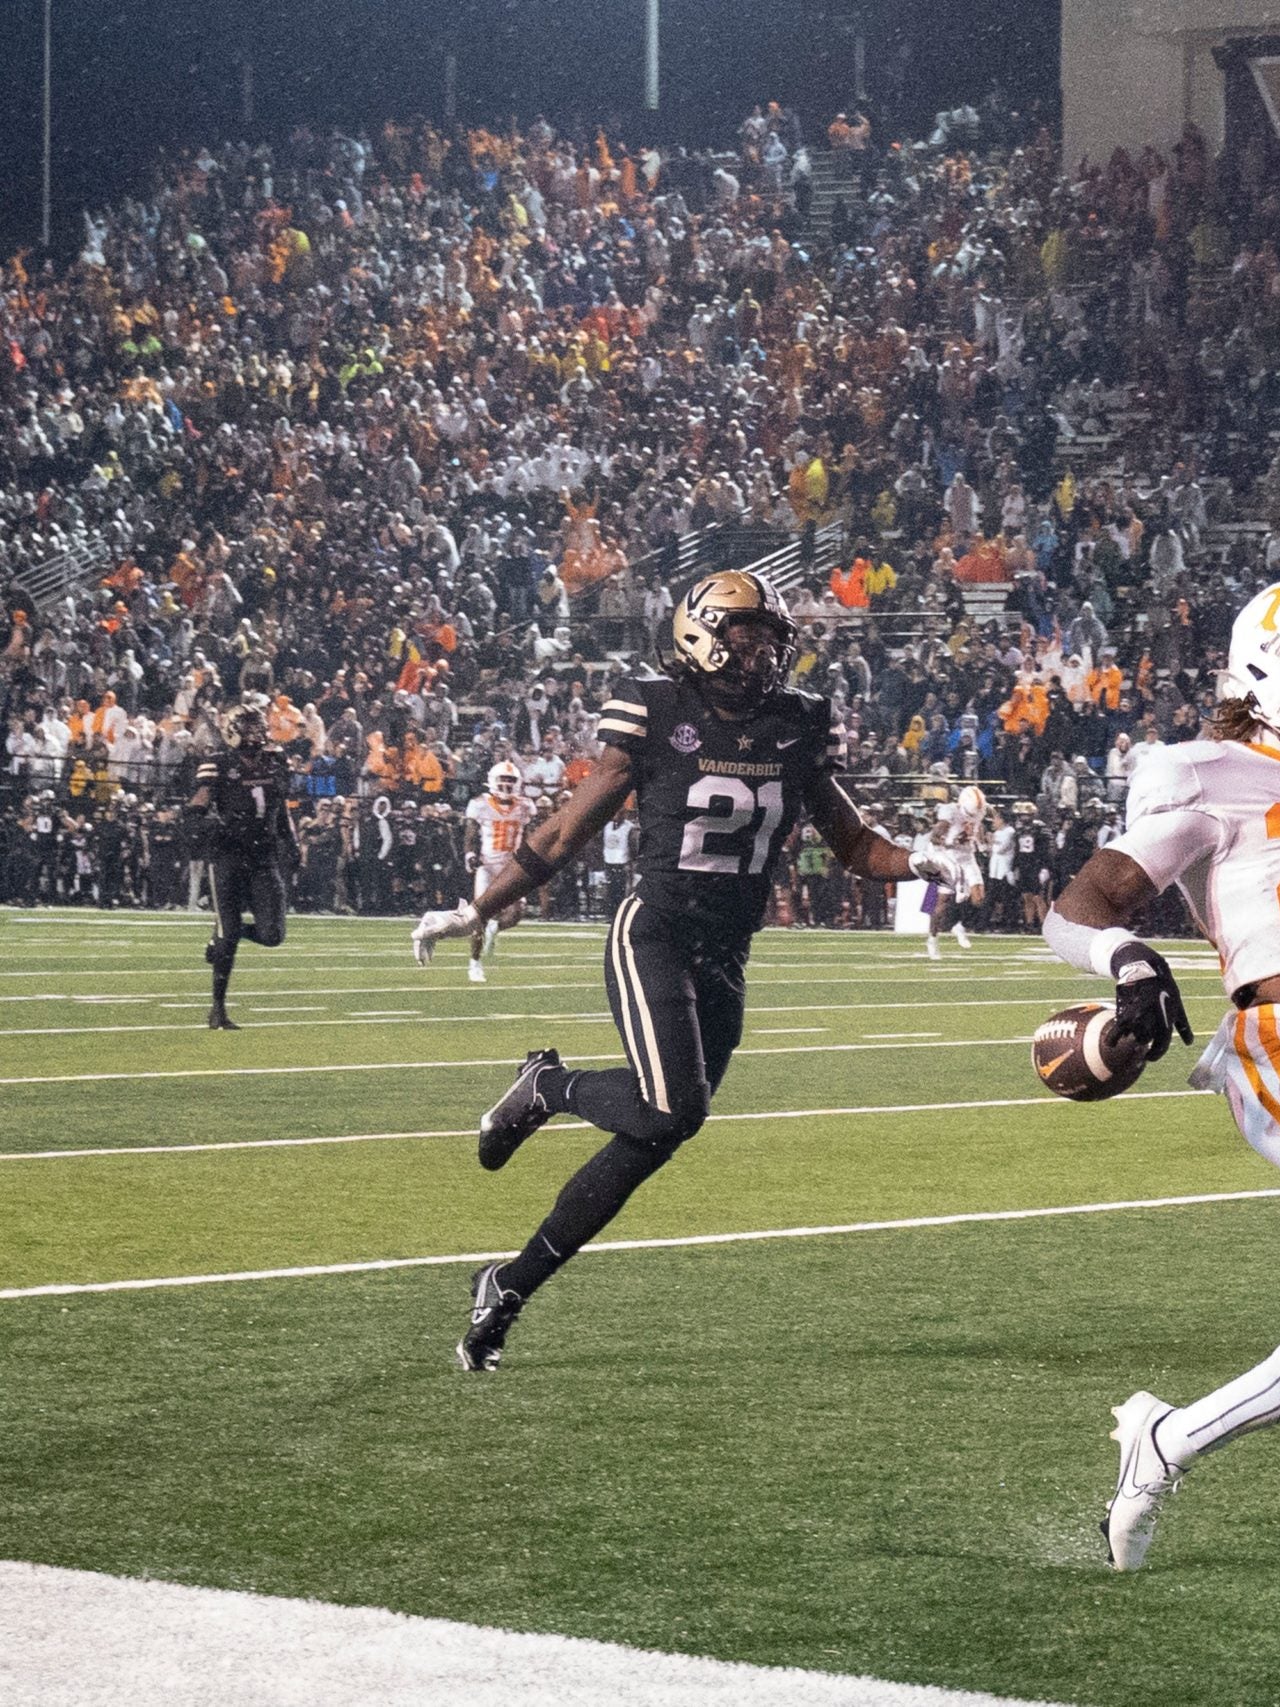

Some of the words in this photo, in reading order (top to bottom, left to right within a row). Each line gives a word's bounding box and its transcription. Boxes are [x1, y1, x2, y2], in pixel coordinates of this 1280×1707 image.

[698, 758, 783, 776] VANDERBILT
[251, 786, 266, 818] 1
[492, 820, 521, 852] 10
[678, 775, 784, 874] 21
